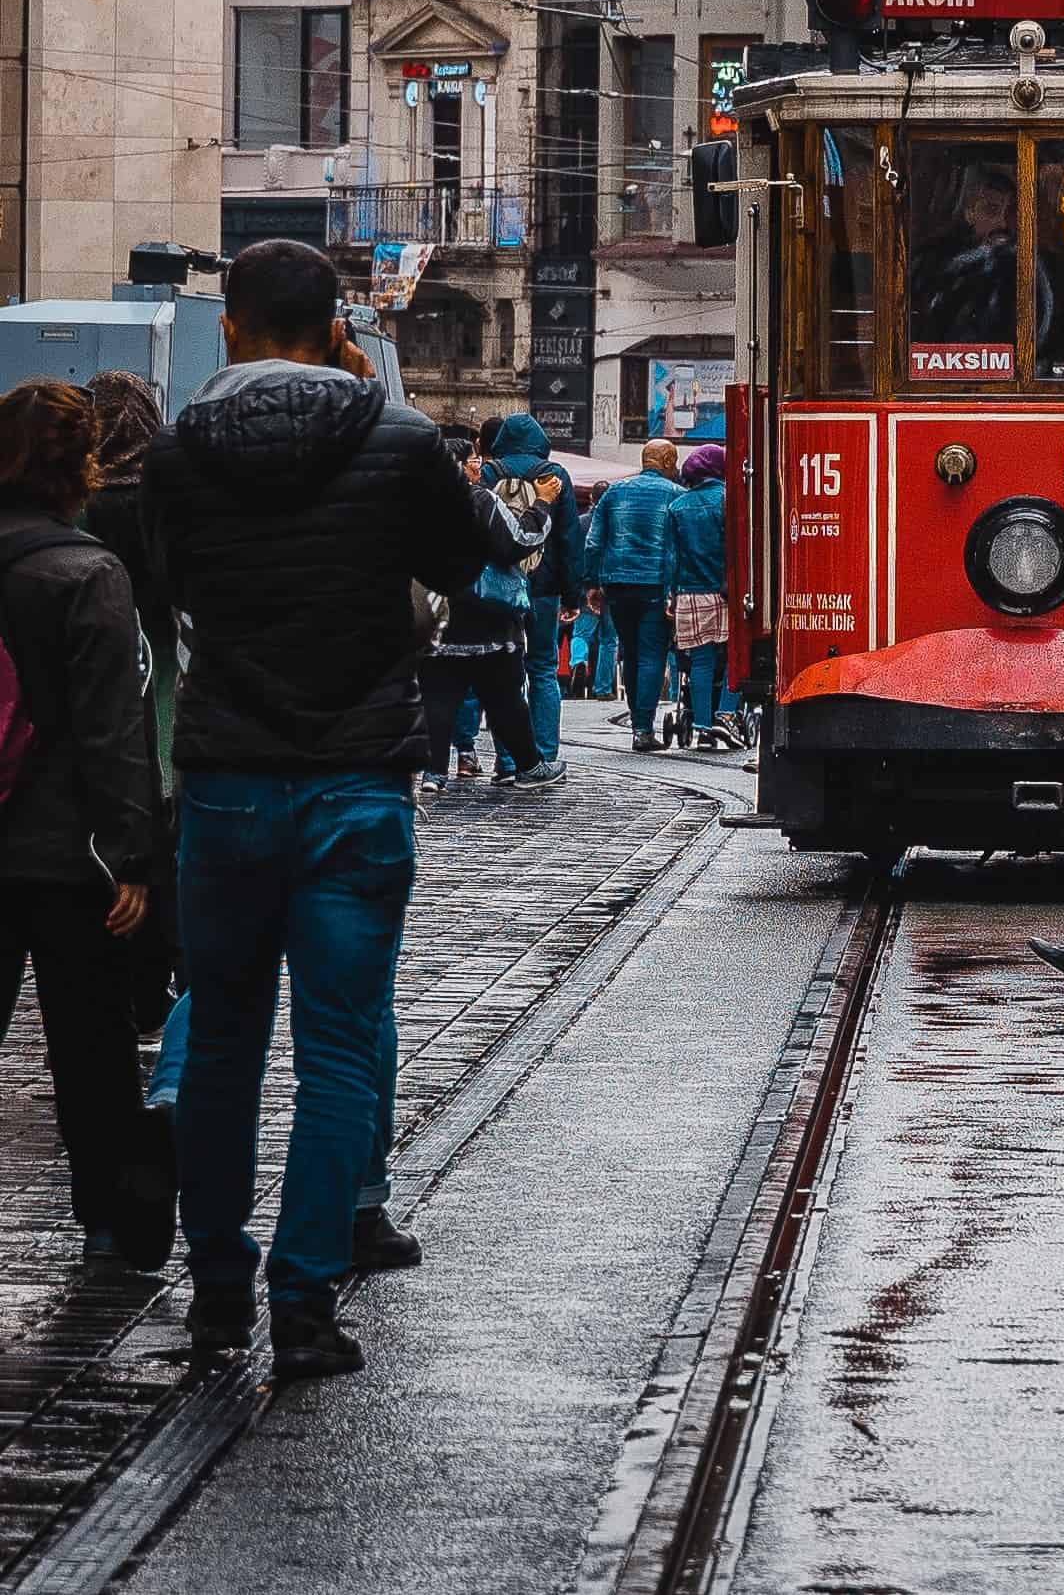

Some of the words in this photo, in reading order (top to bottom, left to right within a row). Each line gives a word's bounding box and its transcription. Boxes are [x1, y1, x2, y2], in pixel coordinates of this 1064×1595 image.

[911, 348, 1010, 370] TAKSİM
[800, 453, 841, 496] 115
[801, 525, 818, 536] ALO
[820, 524, 840, 537] 153
[817, 593, 852, 611] YASAK
